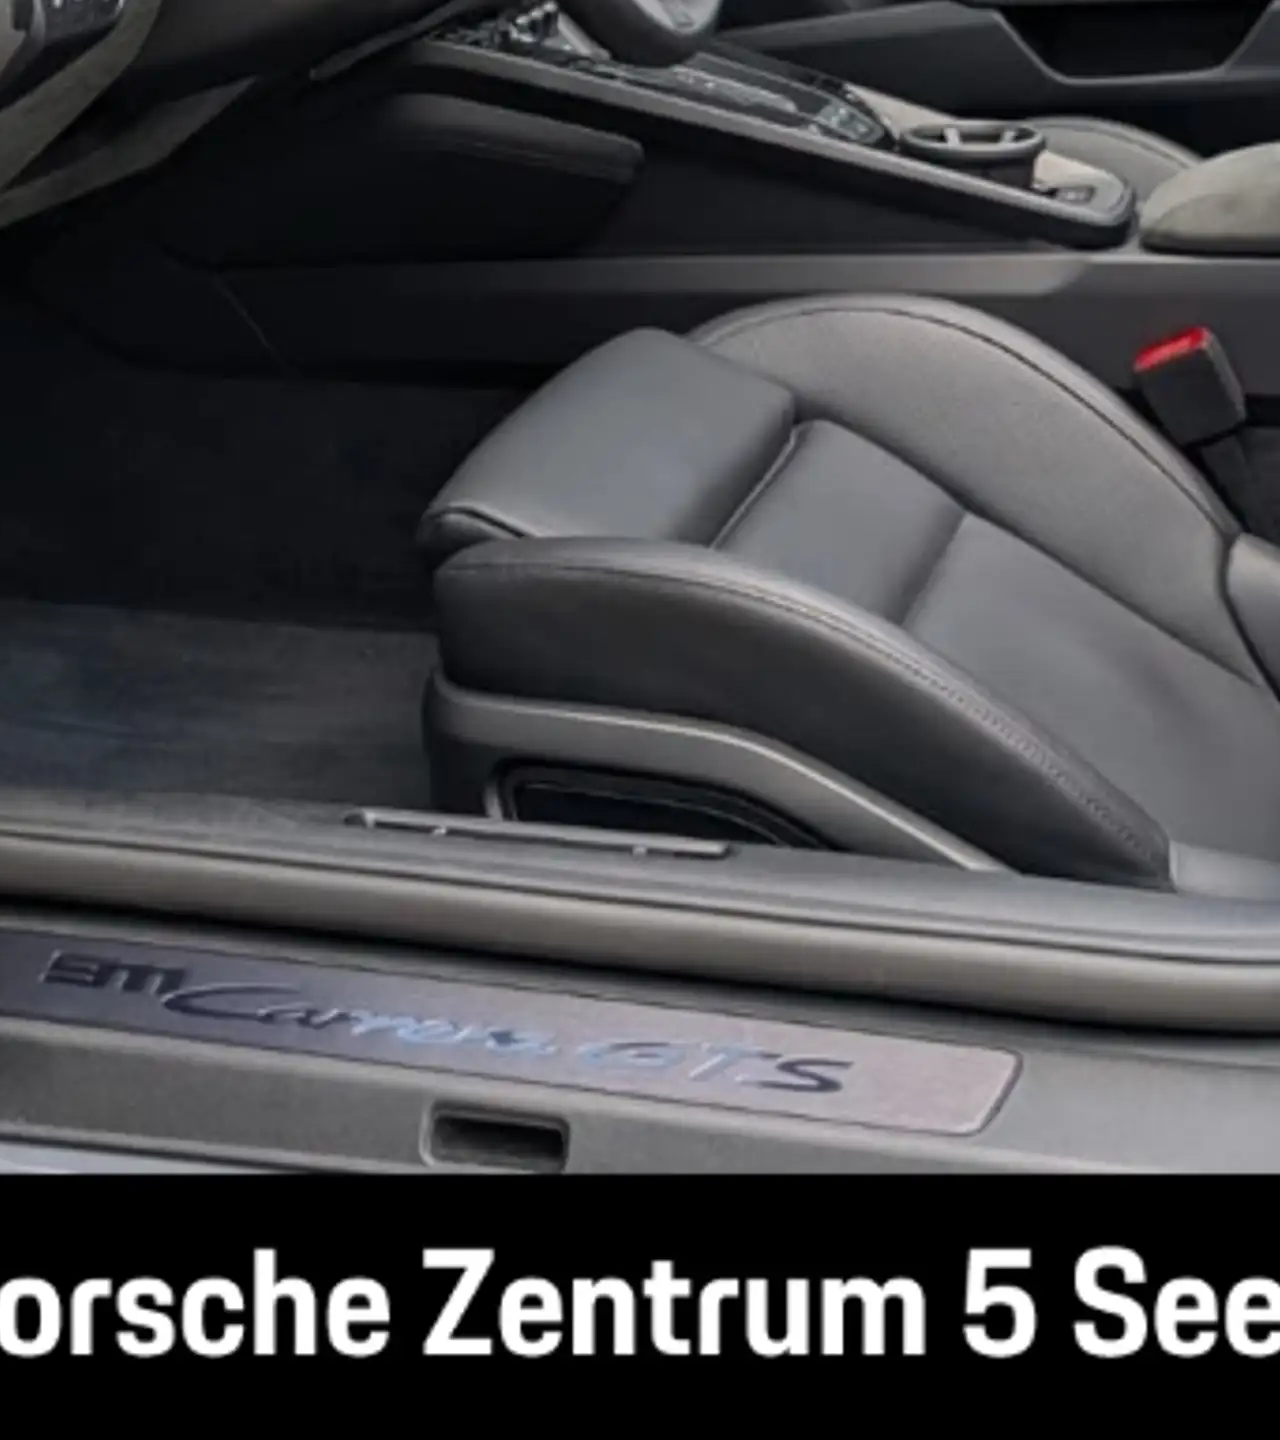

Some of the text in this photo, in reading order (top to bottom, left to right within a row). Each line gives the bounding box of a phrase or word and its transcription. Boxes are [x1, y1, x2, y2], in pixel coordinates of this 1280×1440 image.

[38, 947, 854, 1094] 911 Carrera GTS
